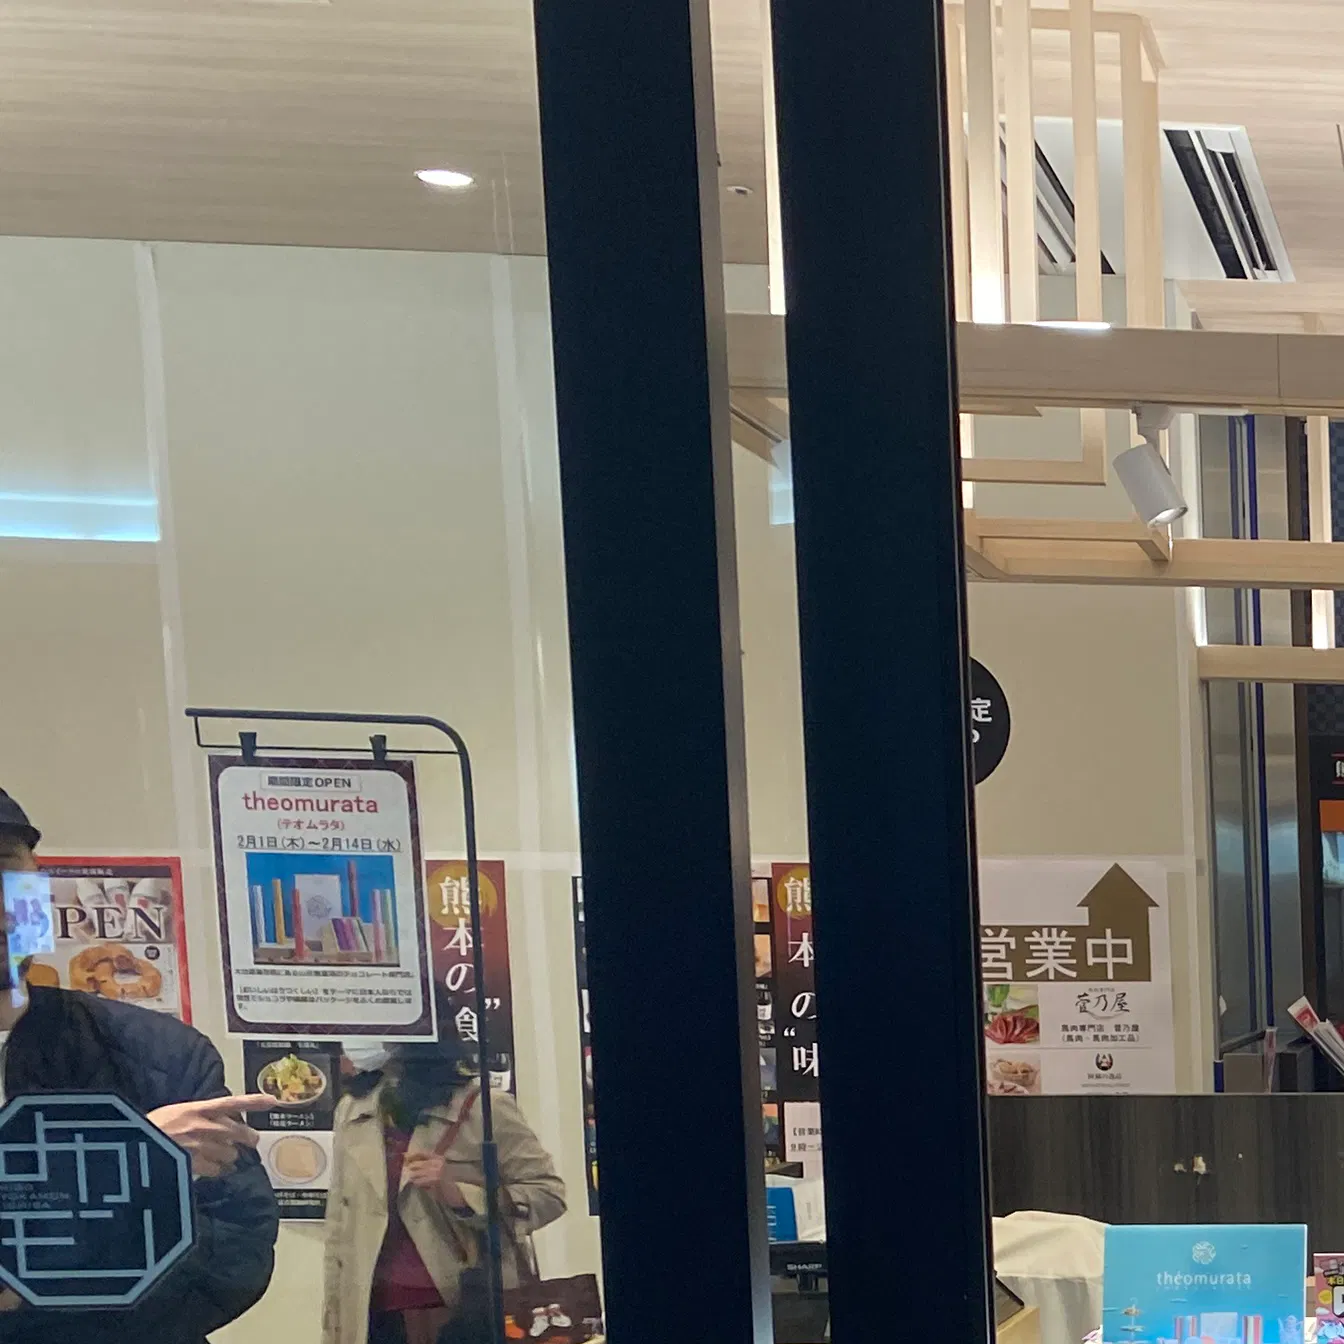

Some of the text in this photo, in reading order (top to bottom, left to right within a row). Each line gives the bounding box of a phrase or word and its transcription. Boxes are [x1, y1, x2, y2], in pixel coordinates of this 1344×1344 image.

[242, 791, 379, 814] theomurata
[981, 927, 1133, 980] 営業中
